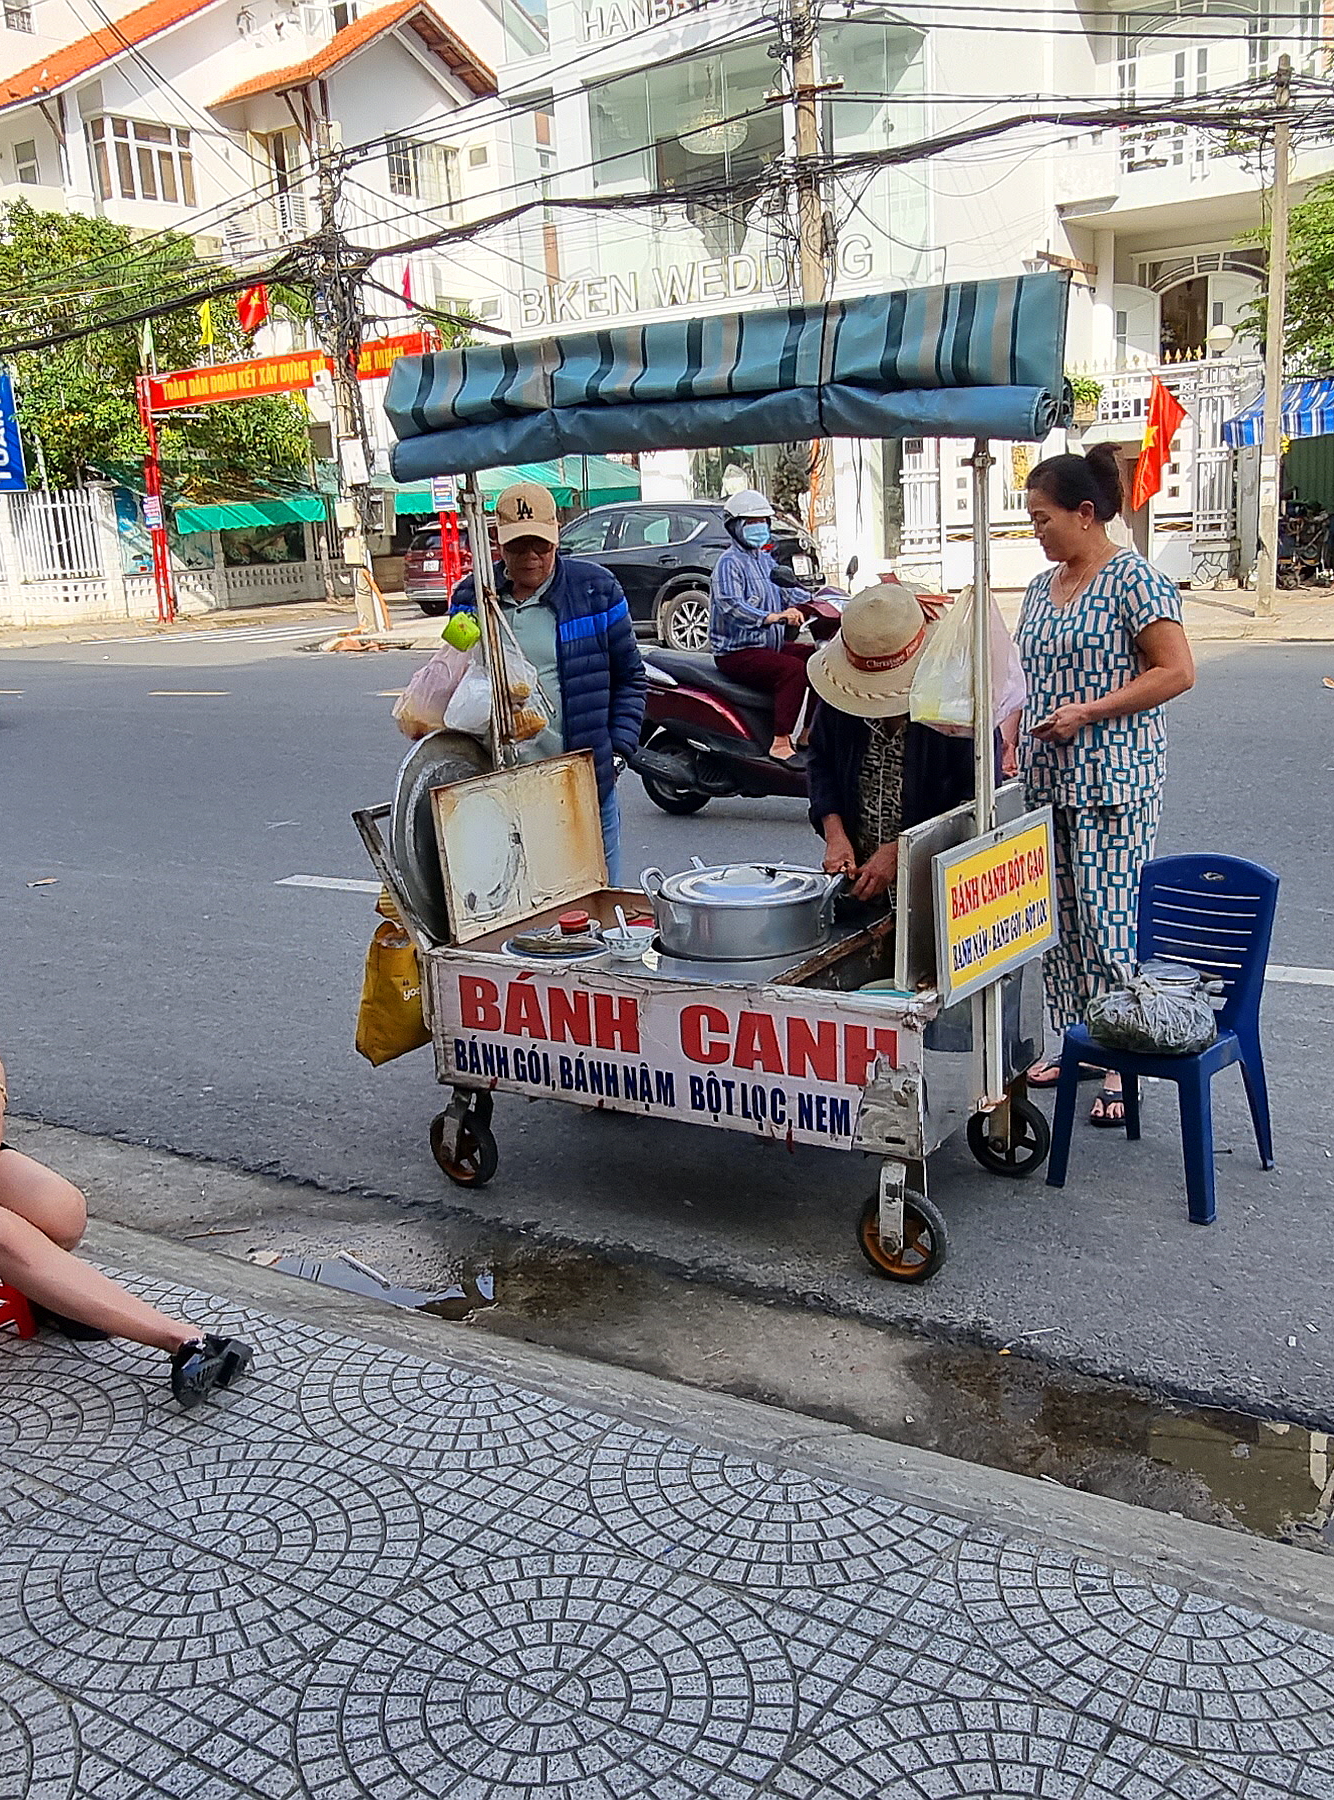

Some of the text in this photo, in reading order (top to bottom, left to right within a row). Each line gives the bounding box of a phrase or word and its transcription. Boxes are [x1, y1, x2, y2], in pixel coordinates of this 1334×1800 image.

[518, 271, 639, 328] BIKEN
[237, 363, 257, 388] KẾT
[258, 363, 278, 386] XÂY
[516, 498, 534, 520] LA
[951, 846, 1045, 920] BÁNH CANH BỘT GẠO
[458, 971, 899, 1087] BÁNH CANH
[454, 1034, 510, 1081] BÁNH
[513, 1035, 556, 1092] GÓI,
[560, 1051, 620, 1098] BÁNH
[623, 1060, 675, 1112] NẬM
[690, 1070, 736, 1122] BỘT
[798, 1092, 850, 1136] NEM
